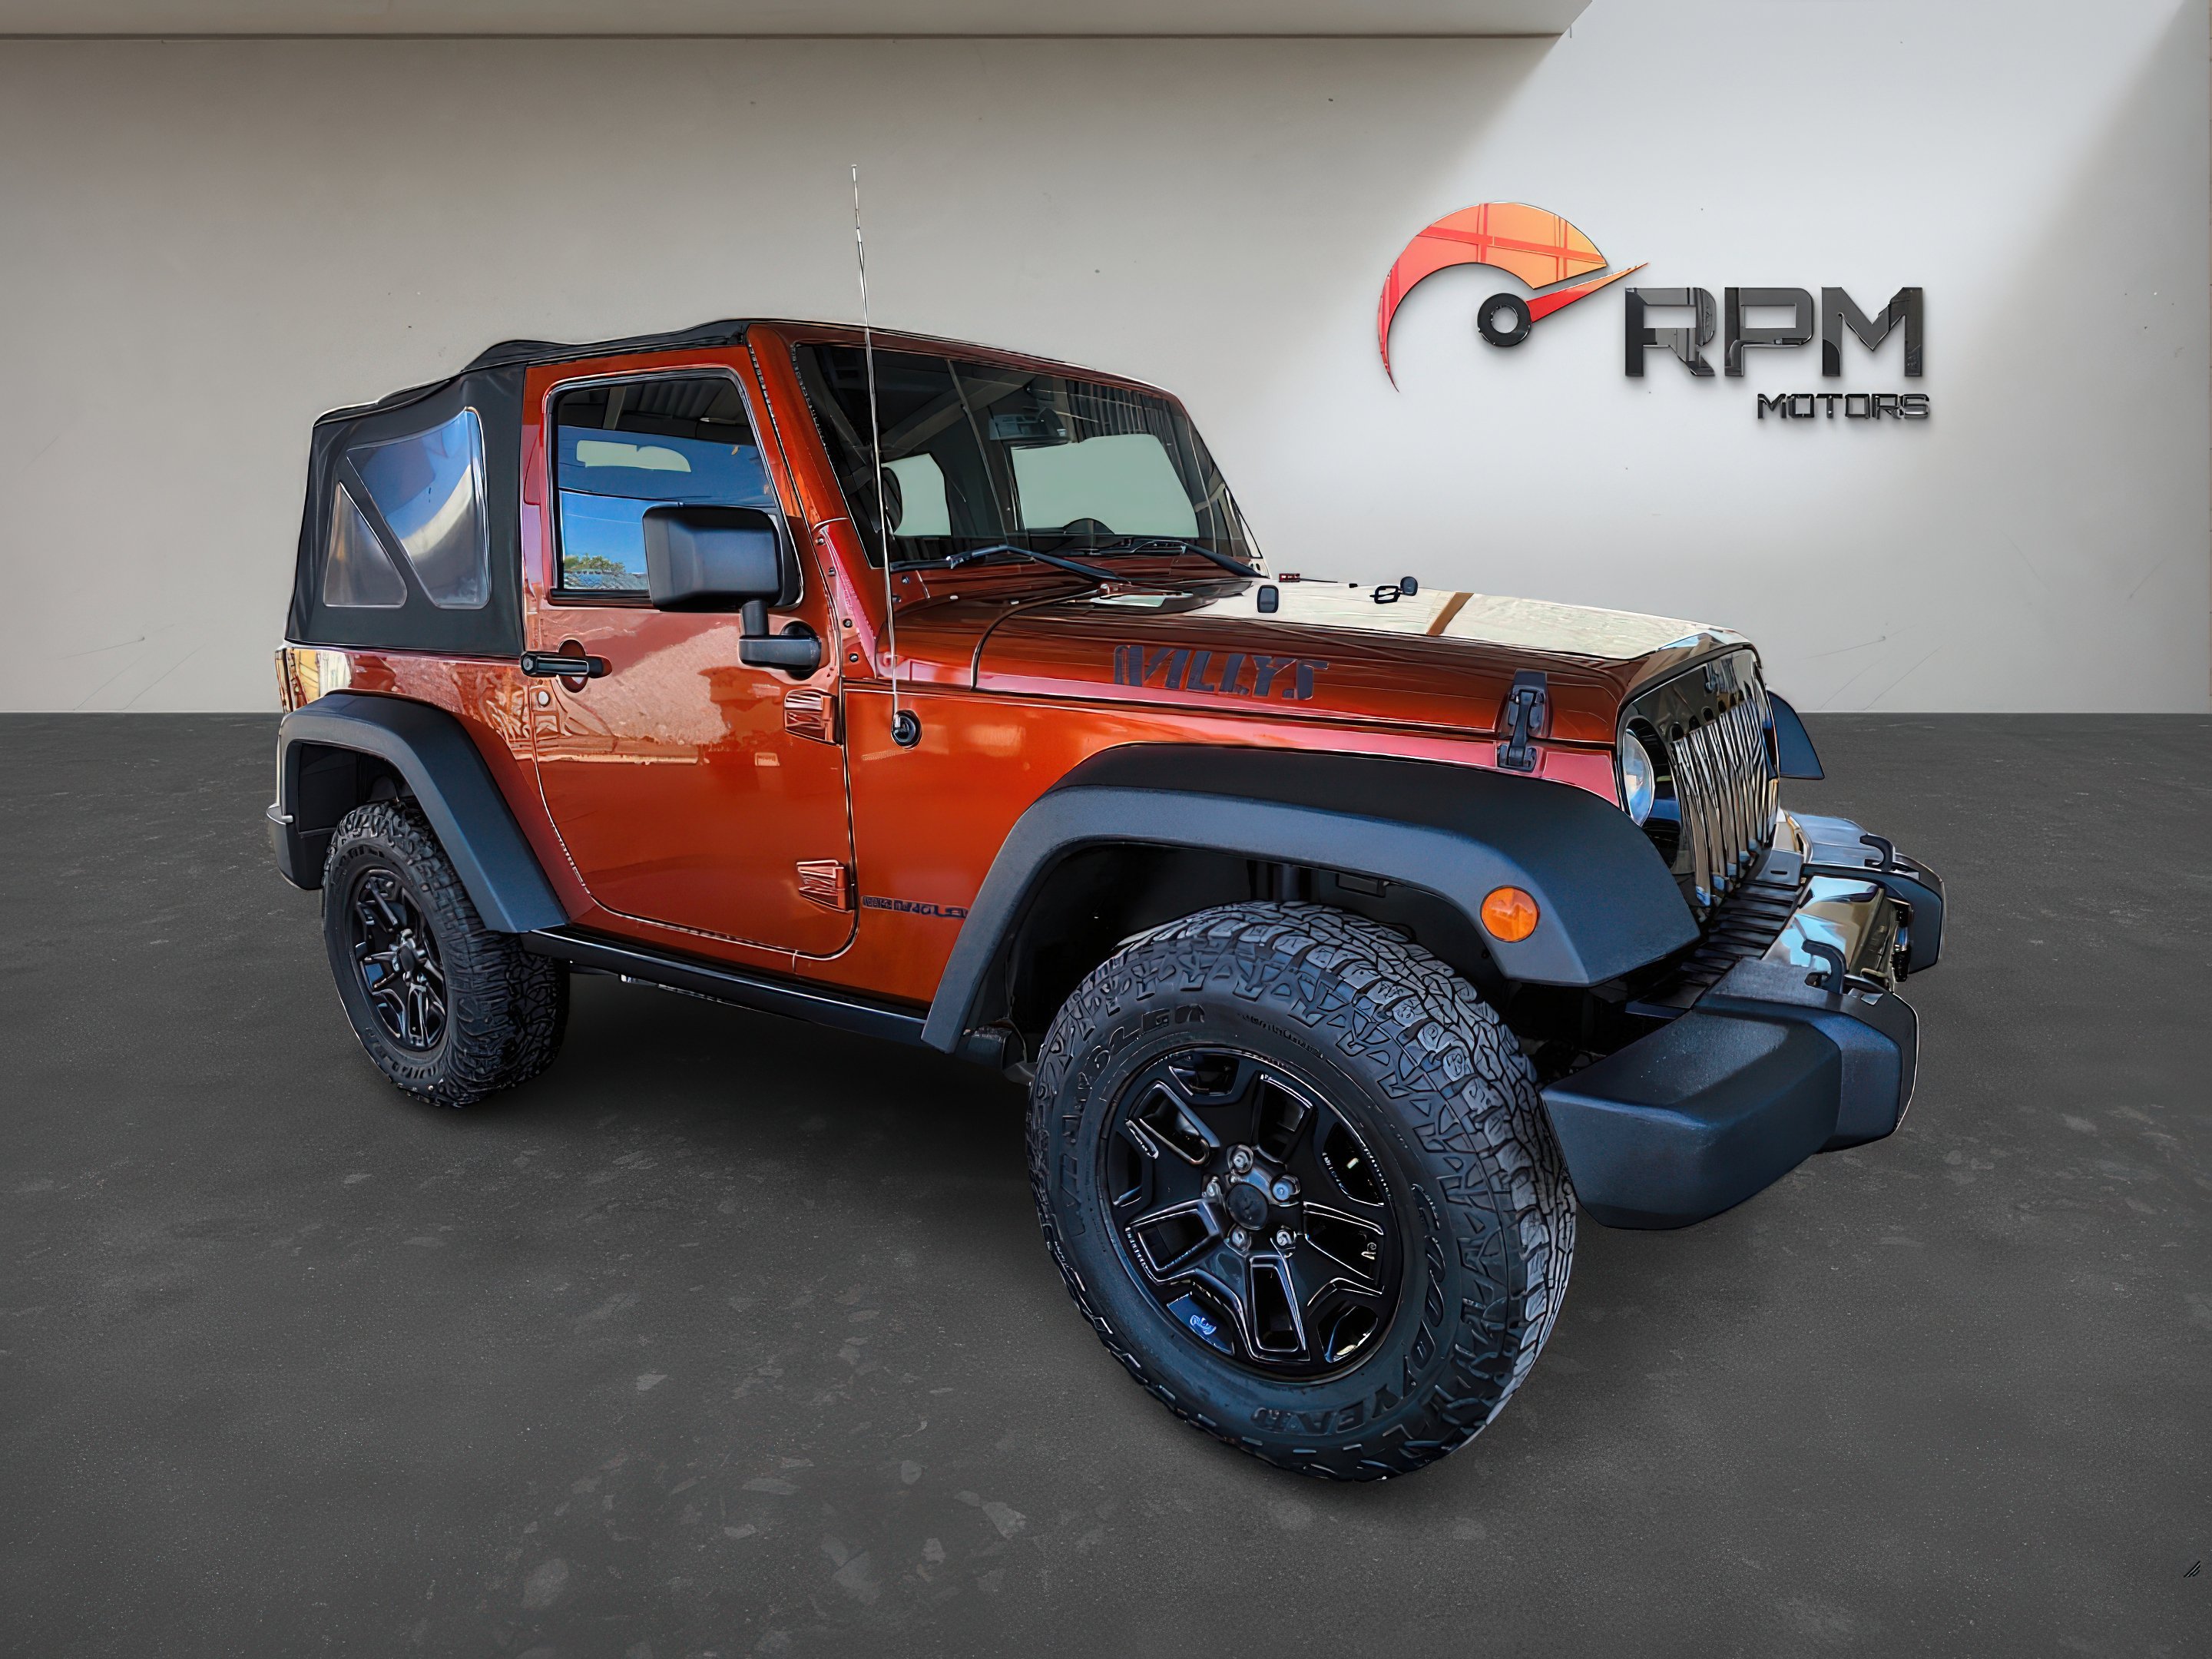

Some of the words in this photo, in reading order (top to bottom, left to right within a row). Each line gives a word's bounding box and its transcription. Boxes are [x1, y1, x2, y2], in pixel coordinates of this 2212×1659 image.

[1625, 286, 1923, 377] RPM
[1757, 393, 1930, 419] MOTORS
[1114, 644, 1330, 700] WILLYS
